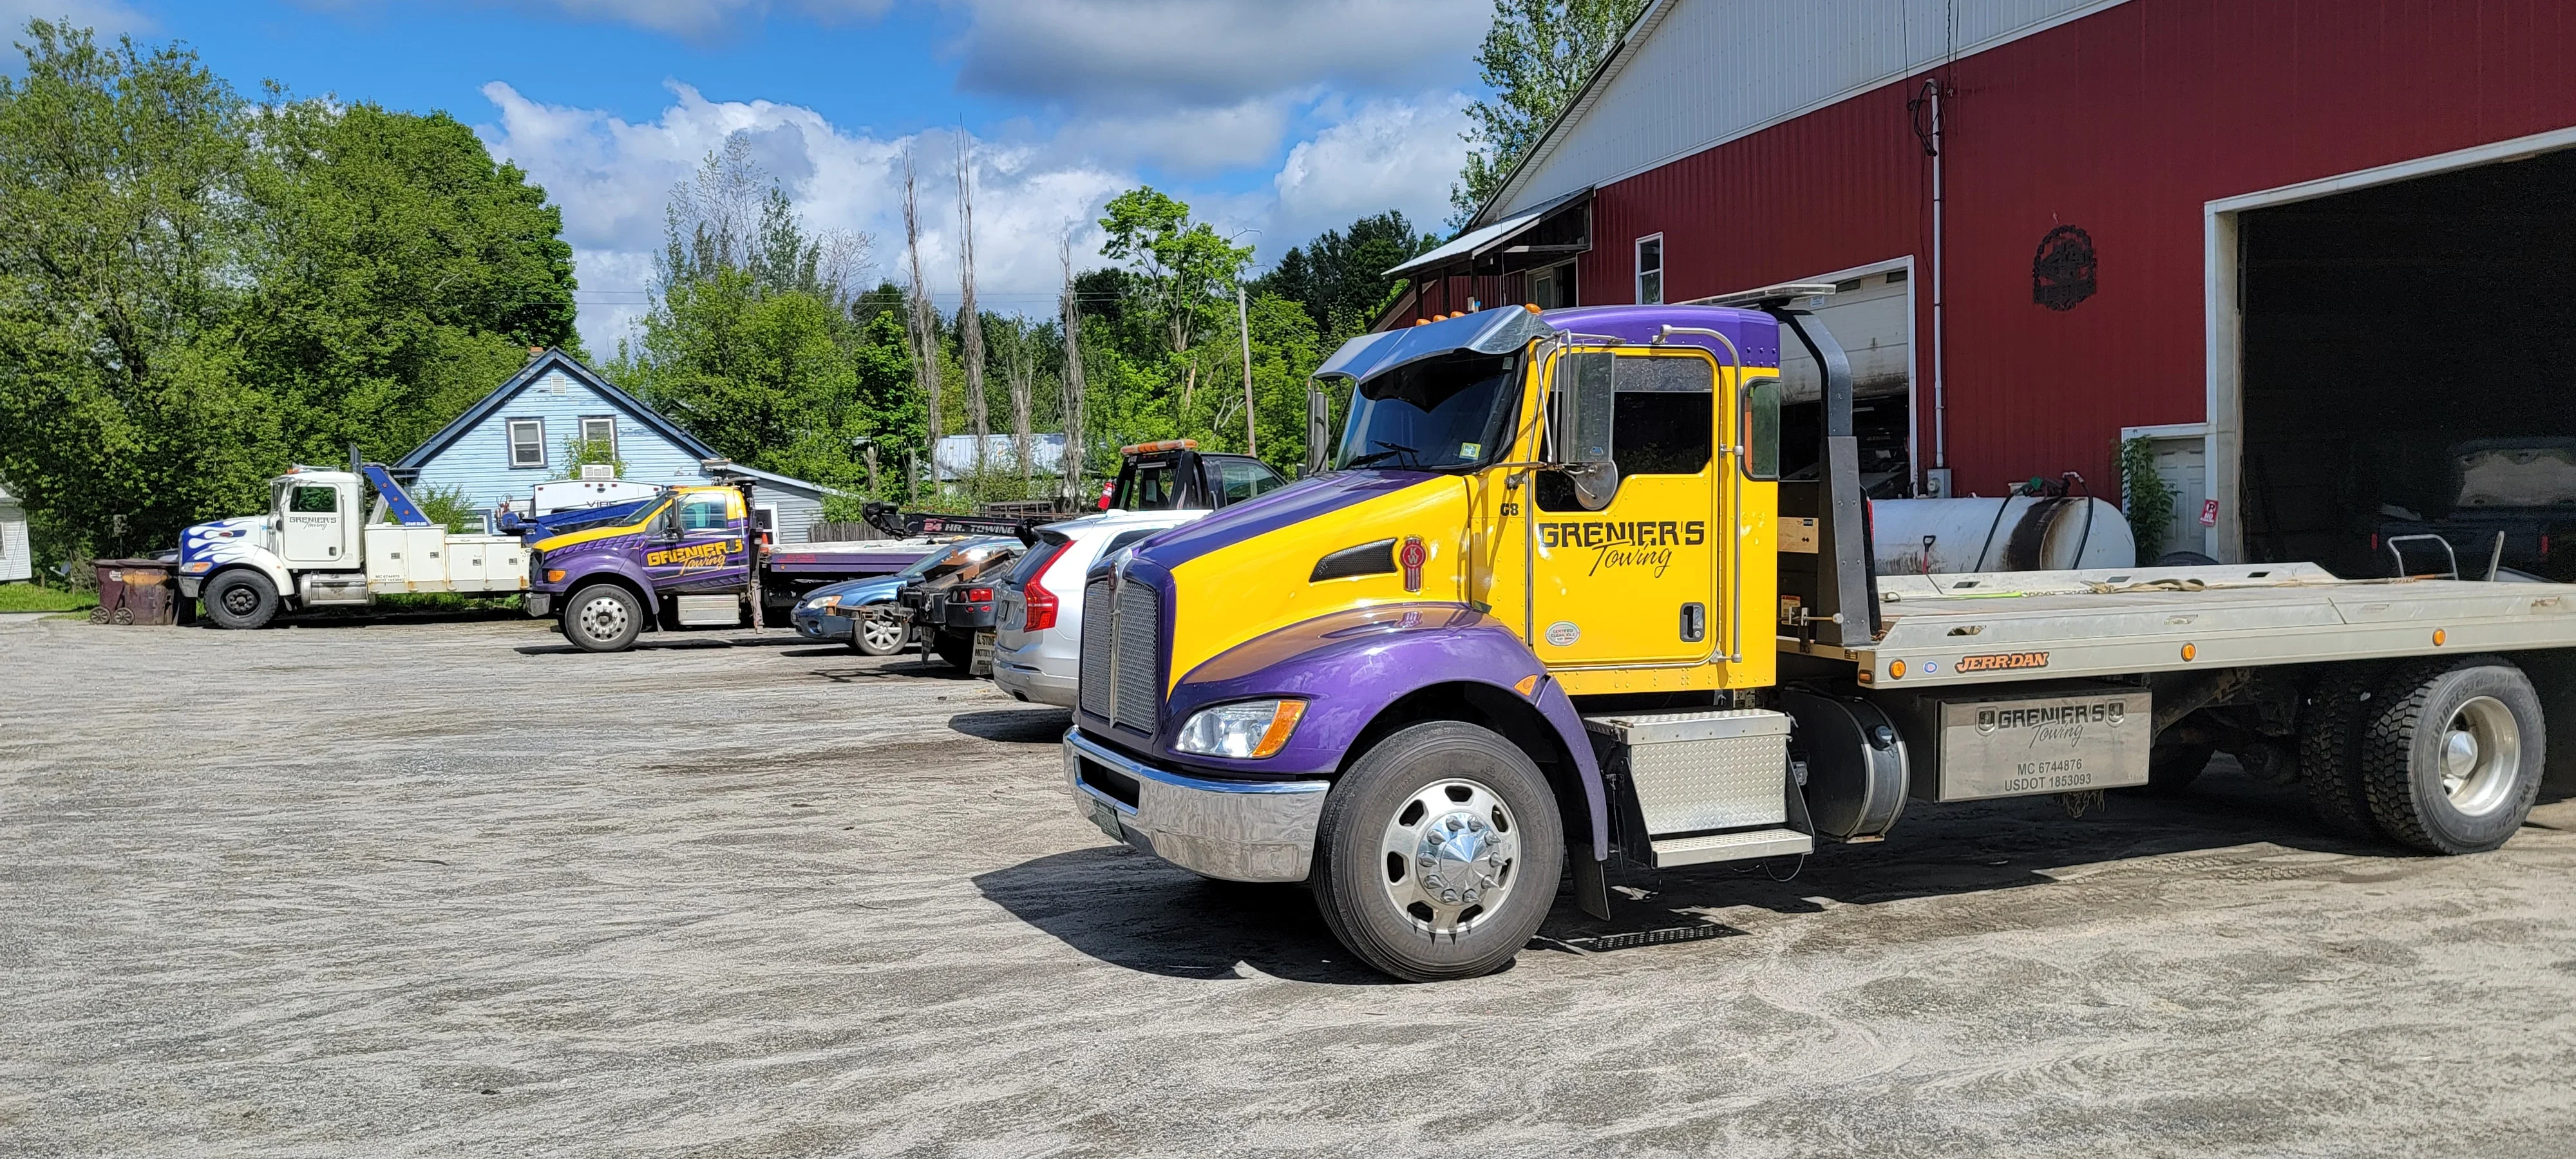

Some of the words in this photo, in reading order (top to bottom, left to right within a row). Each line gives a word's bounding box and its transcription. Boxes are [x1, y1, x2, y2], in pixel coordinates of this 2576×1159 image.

[1501, 503, 1519, 516] G8
[2204, 512, 2213, 520] NO
[923, 523, 942, 531] 24
[944, 523, 965, 532] HR.
[971, 525, 1016, 534] TOWING
[1537, 521, 1705, 547] GRENIER'S
[679, 554, 726, 575] Towing
[1588, 539, 1672, 579] Towing
[1998, 704, 2105, 729] GRENIER'S
[2029, 721, 2085, 749] Towing
[2018, 763, 2036, 776] MC
[2038, 758, 2083, 774] 6744876
[2005, 777, 2046, 791] USDOT
[2049, 773, 2092, 787] 1853093
